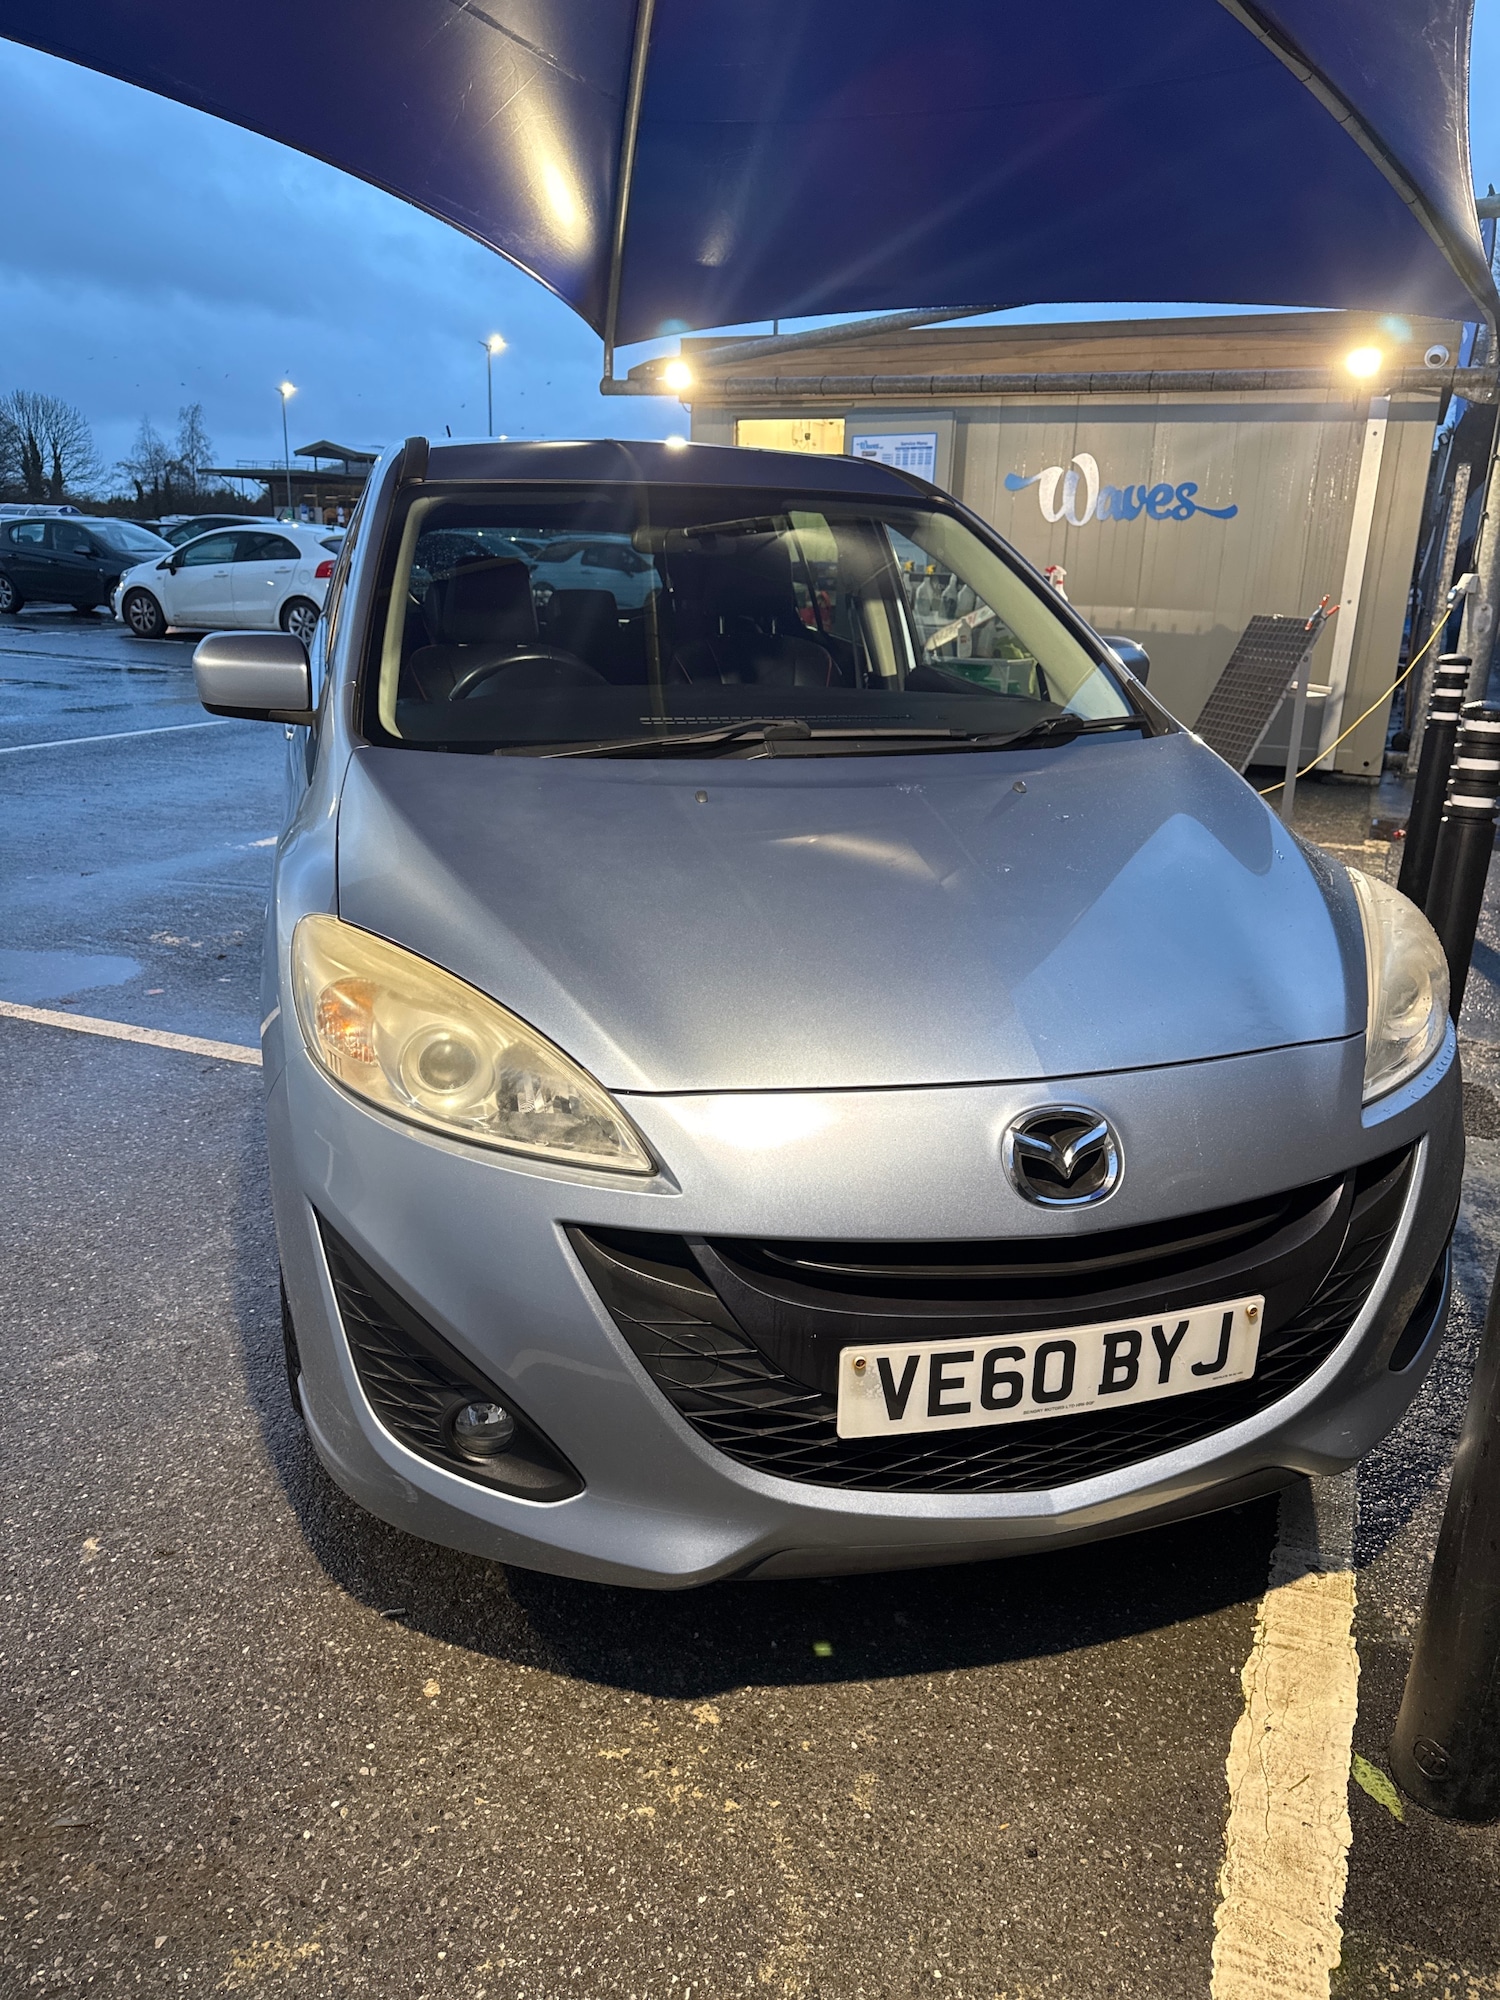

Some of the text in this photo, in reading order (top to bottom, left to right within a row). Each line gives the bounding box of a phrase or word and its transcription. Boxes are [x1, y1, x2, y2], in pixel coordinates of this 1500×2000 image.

[1004, 452, 1239, 527] Waves
[877, 1311, 1234, 1420] VE60 BYJ
